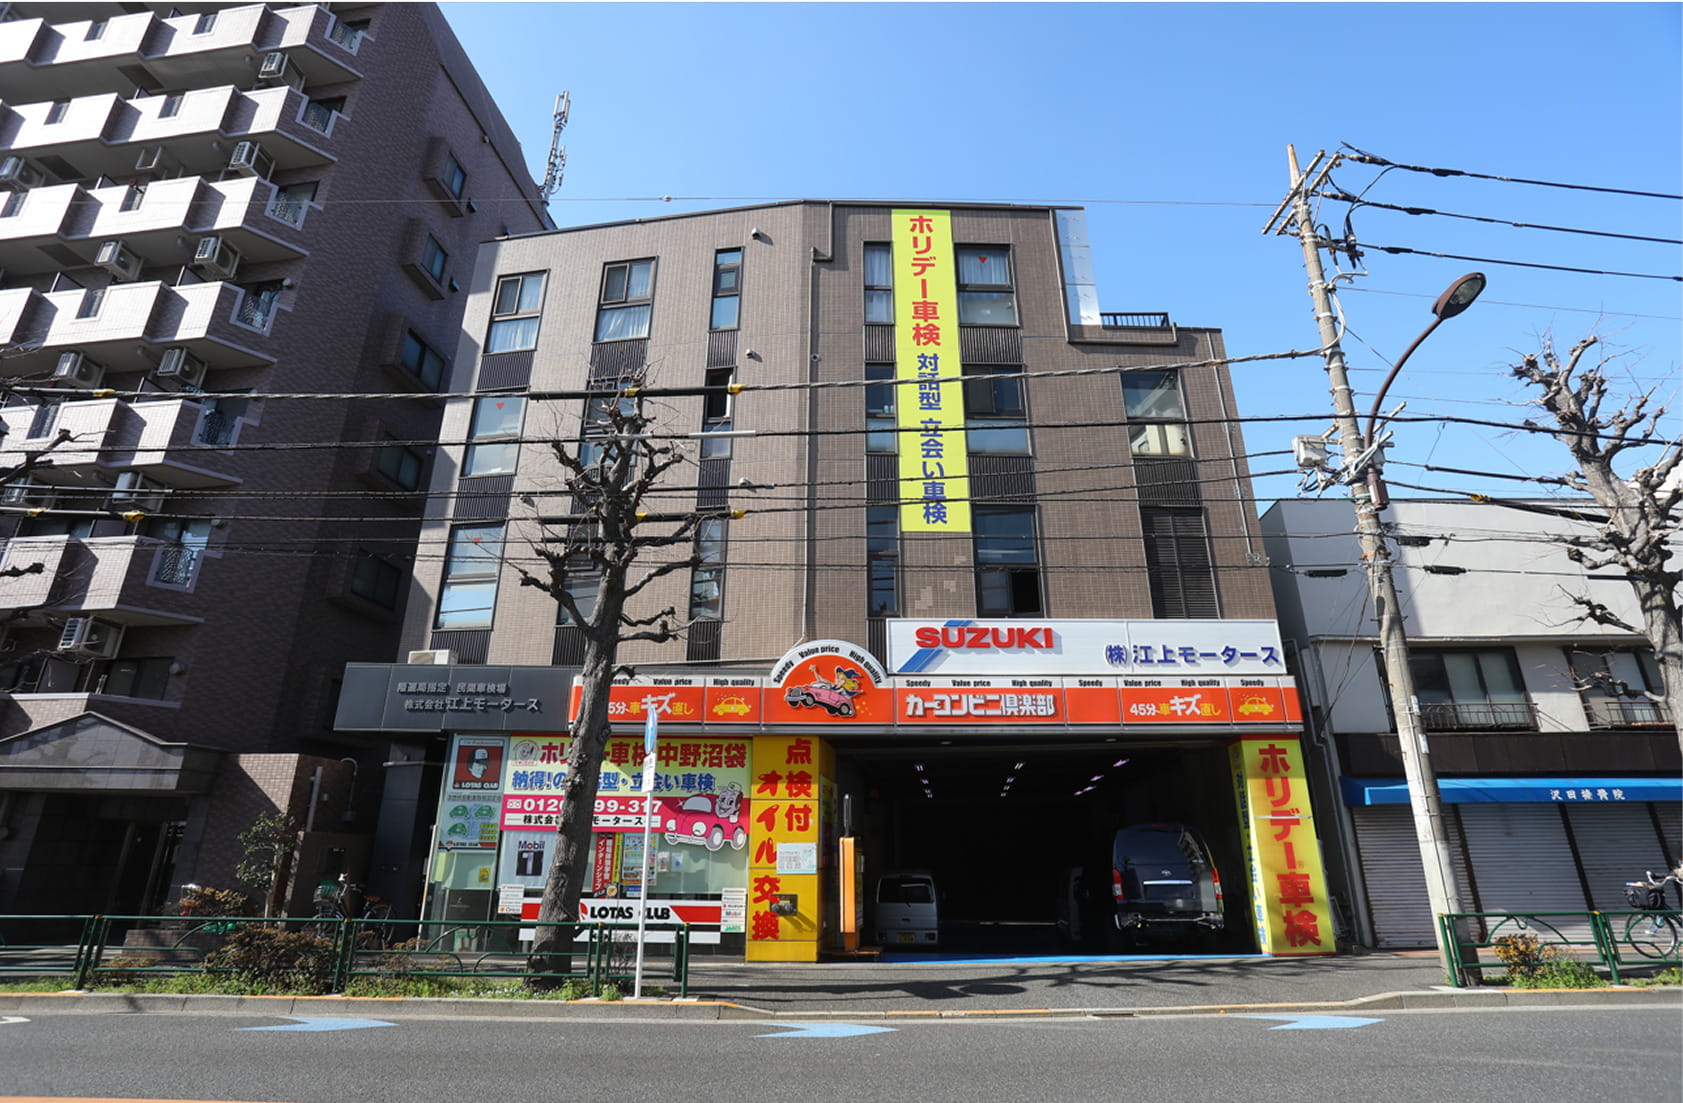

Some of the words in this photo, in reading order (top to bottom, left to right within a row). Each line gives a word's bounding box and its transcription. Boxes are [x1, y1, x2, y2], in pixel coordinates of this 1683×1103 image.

[909, 215, 942, 347] ホリデー車検
[916, 353, 942, 411] 対話型
[919, 418, 948, 525] 立会い車検
[915, 627, 1054, 649] SUZUKI
[798, 646, 820, 659] Value
[820, 645, 840, 654] price
[848, 650, 865, 664] High
[674, 679, 693, 687] price
[713, 678, 729, 686] High
[730, 678, 755, 688] quality
[905, 679, 931, 688] Speedy
[951, 679, 971, 687] Value
[973, 679, 991, 688] price
[1011, 679, 1027, 687] High
[1029, 679, 1053, 688] quality
[1078, 679, 1103, 688] Speedy
[1123, 679, 1143, 687] Value
[1144, 679, 1162, 688] price
[1181, 679, 1196, 687] High
[1197, 679, 1221, 688] quality
[1240, 679, 1265, 687] Speedy
[905, 693, 1056, 717] カーコンビニ倶楽部
[785, 738, 813, 832] 点検付
[518, 840, 546, 850] Mobil
[1258, 744, 1322, 947] ホリデー車検
[751, 770, 783, 940] オイル交換
[590, 906, 634, 919] LOTAS
[638, 907, 670, 920] LUB
